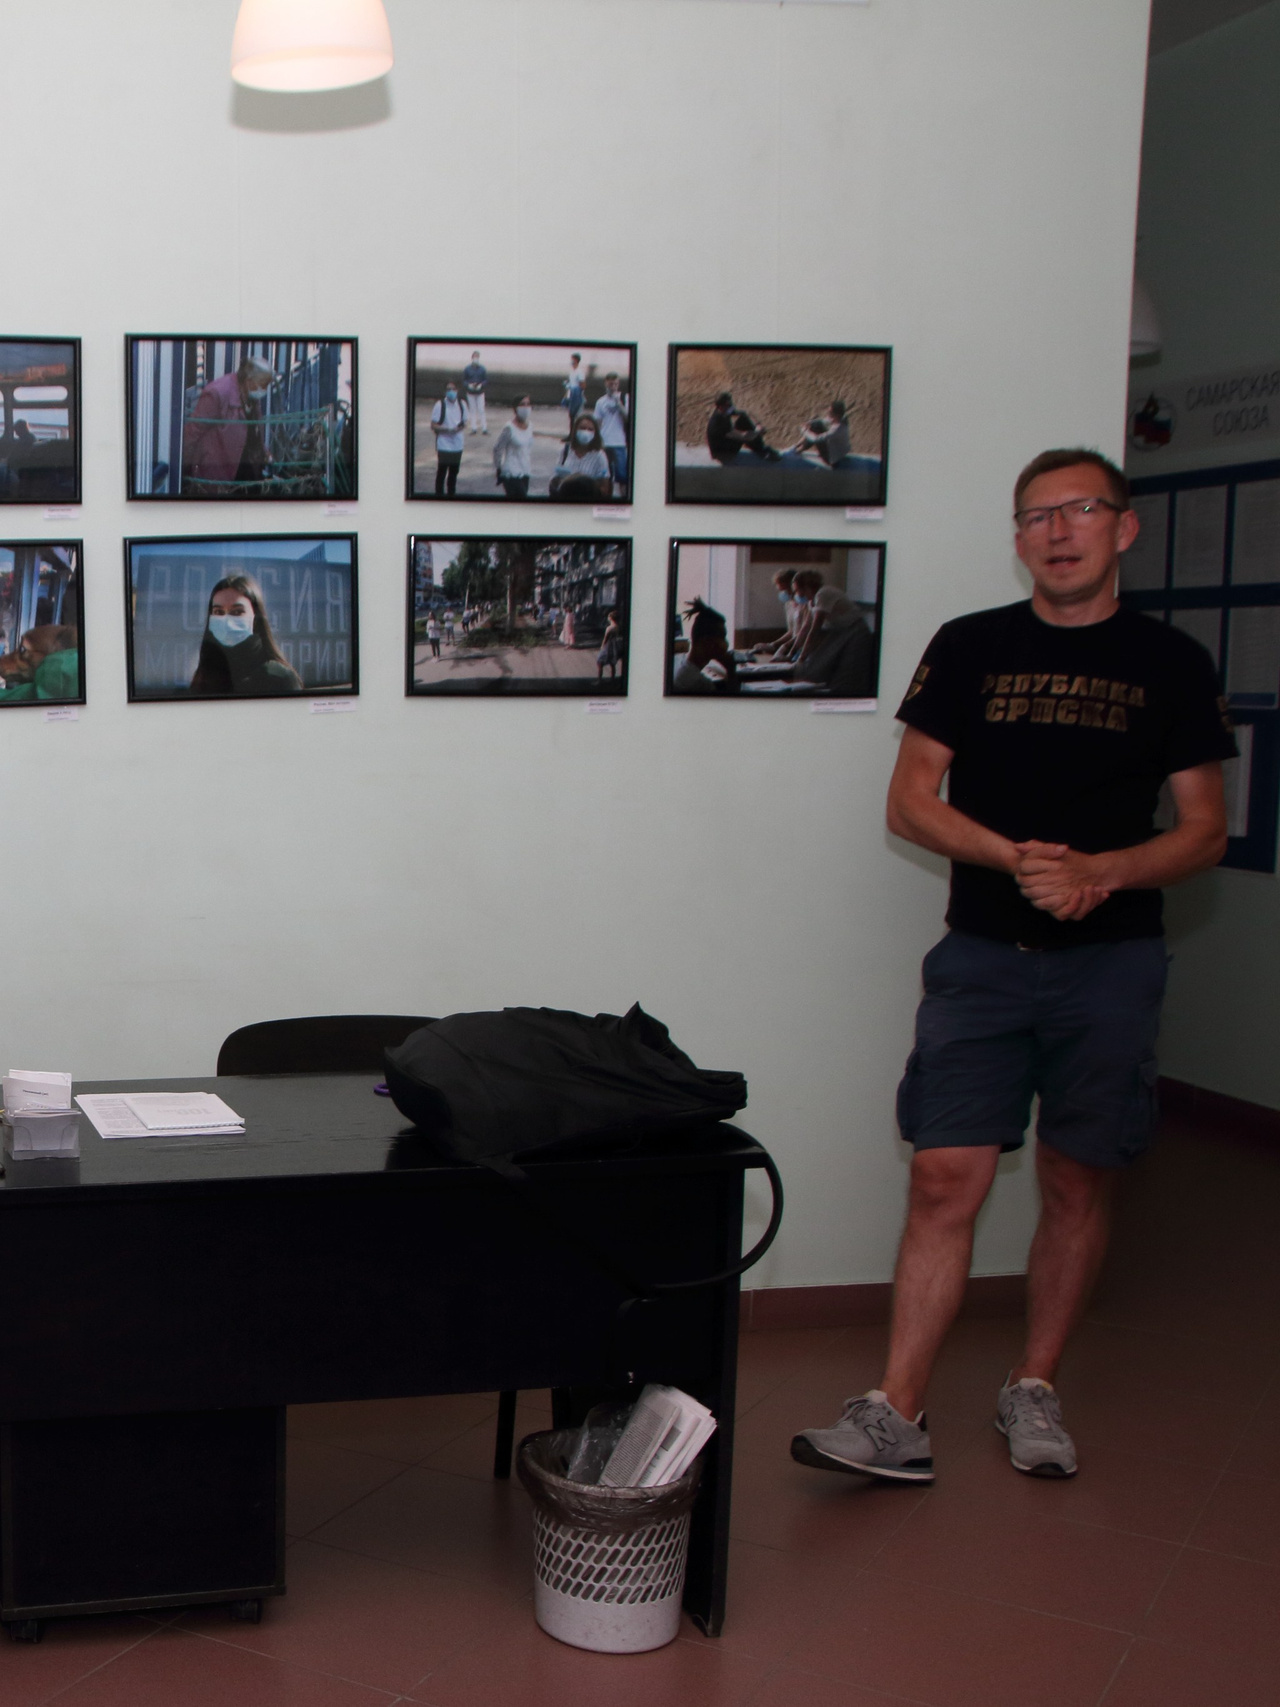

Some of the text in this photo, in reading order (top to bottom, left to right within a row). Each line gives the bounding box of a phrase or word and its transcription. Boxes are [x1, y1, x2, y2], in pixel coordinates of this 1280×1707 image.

[1185, 370, 1280, 412] САМАРСКАЯ
[1212, 404, 1270, 437] СОЮЗА
[980, 673, 1147, 708] РЕПУБЛИКА
[985, 696, 1129, 732] СРПСКА
[863, 1418, 899, 1453] N
